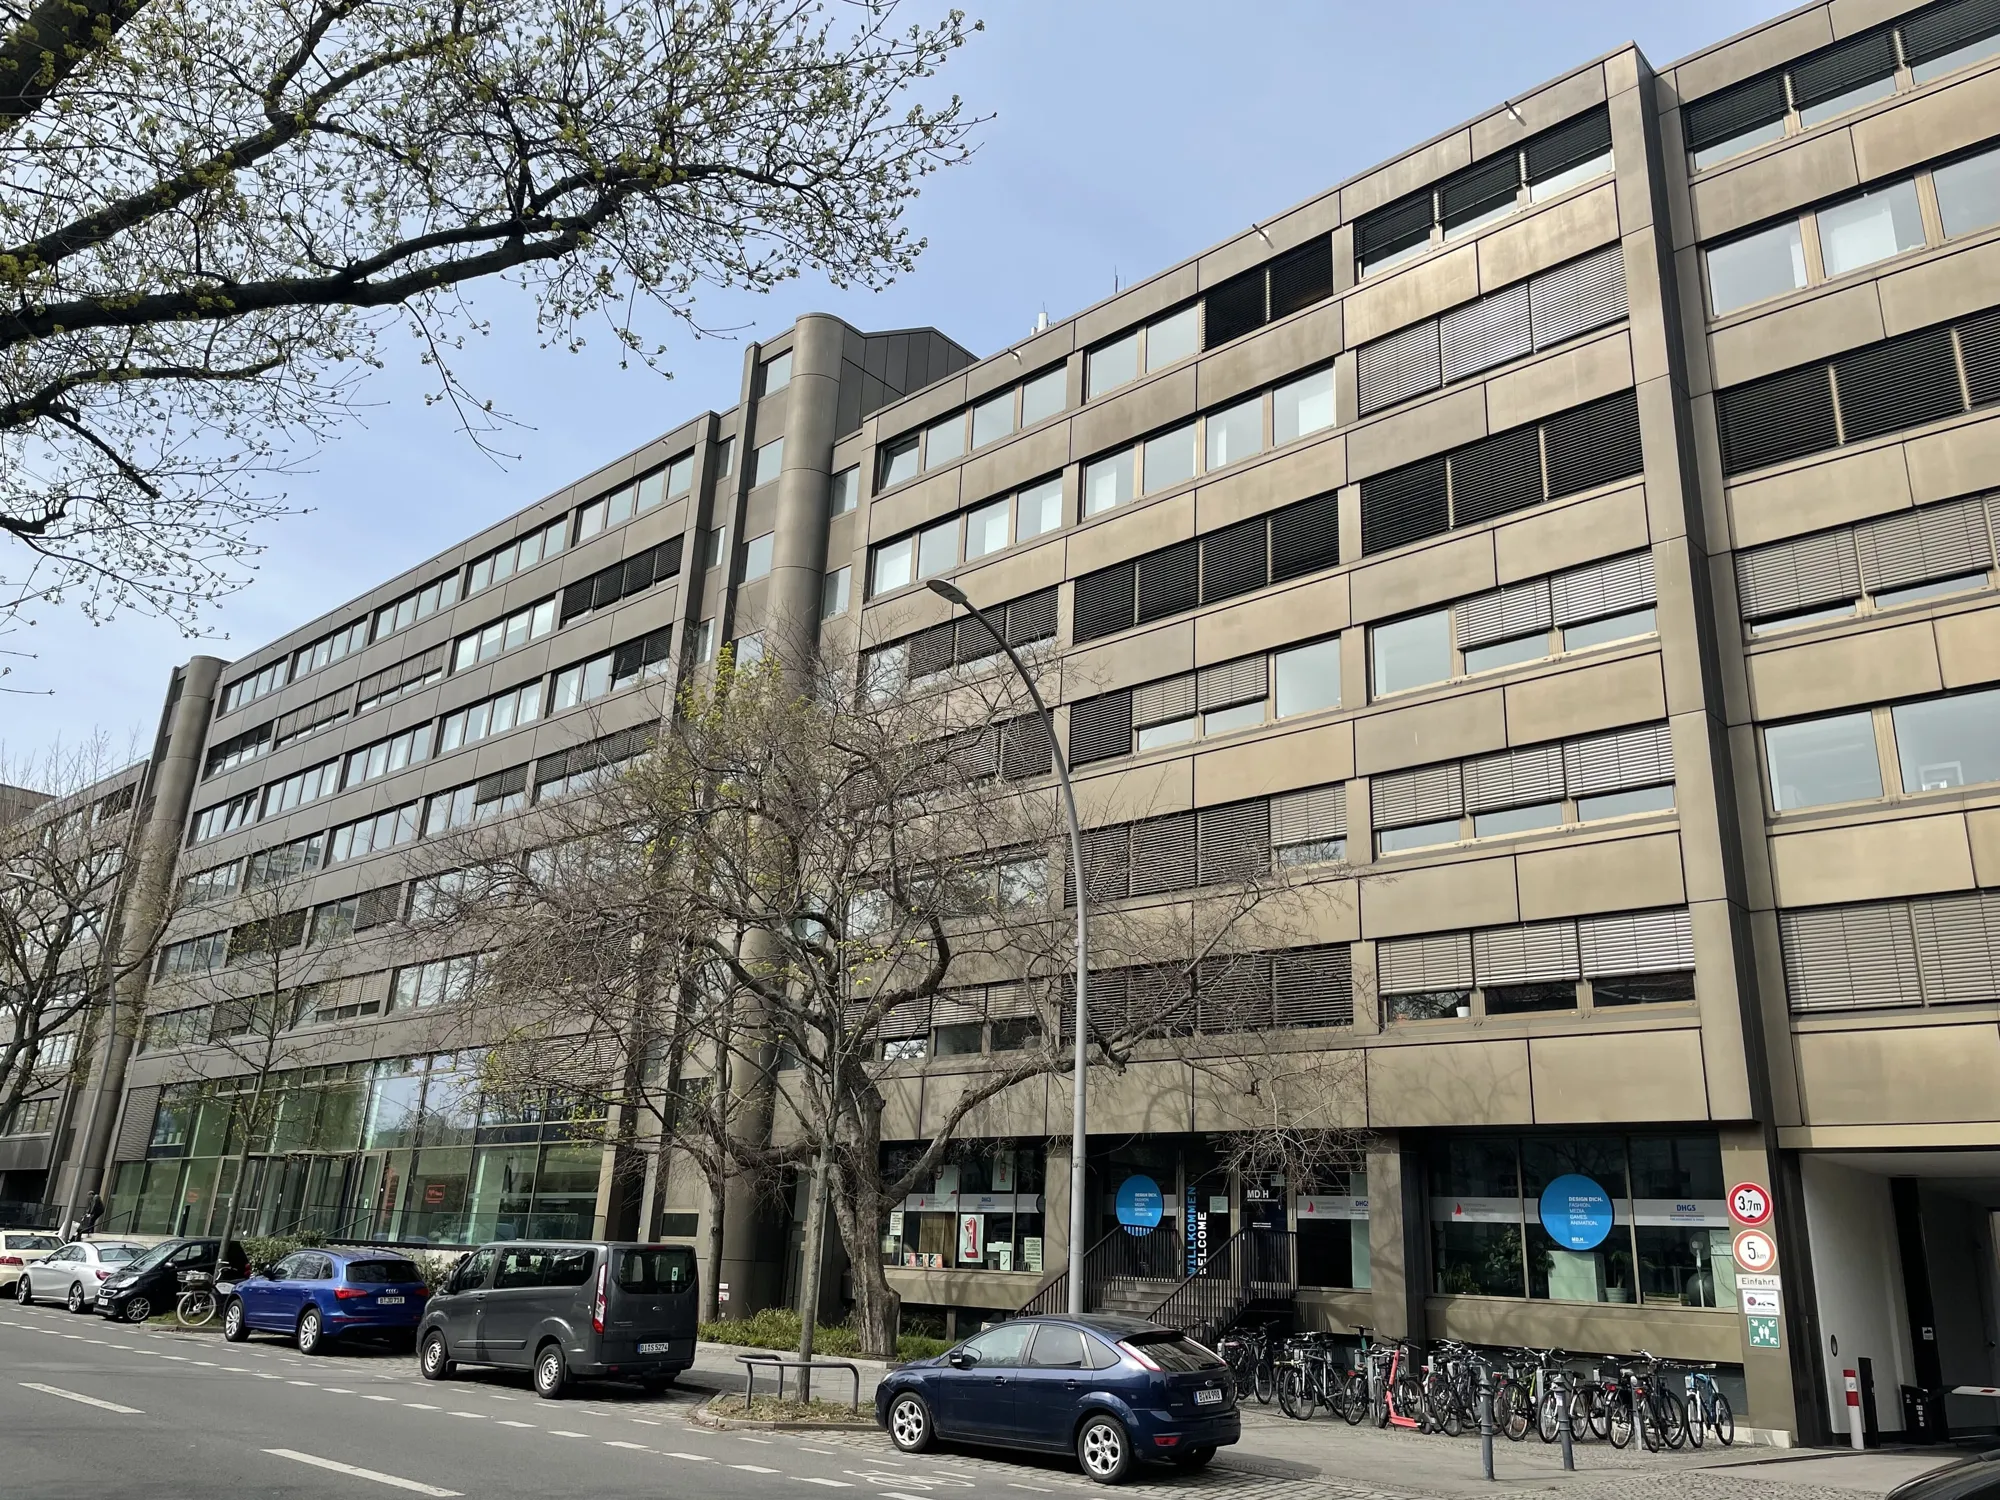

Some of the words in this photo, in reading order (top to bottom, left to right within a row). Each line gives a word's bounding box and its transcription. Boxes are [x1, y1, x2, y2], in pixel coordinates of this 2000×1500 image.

[1676, 1204, 1696, 1212] DHGS
[1187, 1186, 1196, 1275] WILLKOMMEN
[1741, 1277, 1775, 1286] Einfahrt
